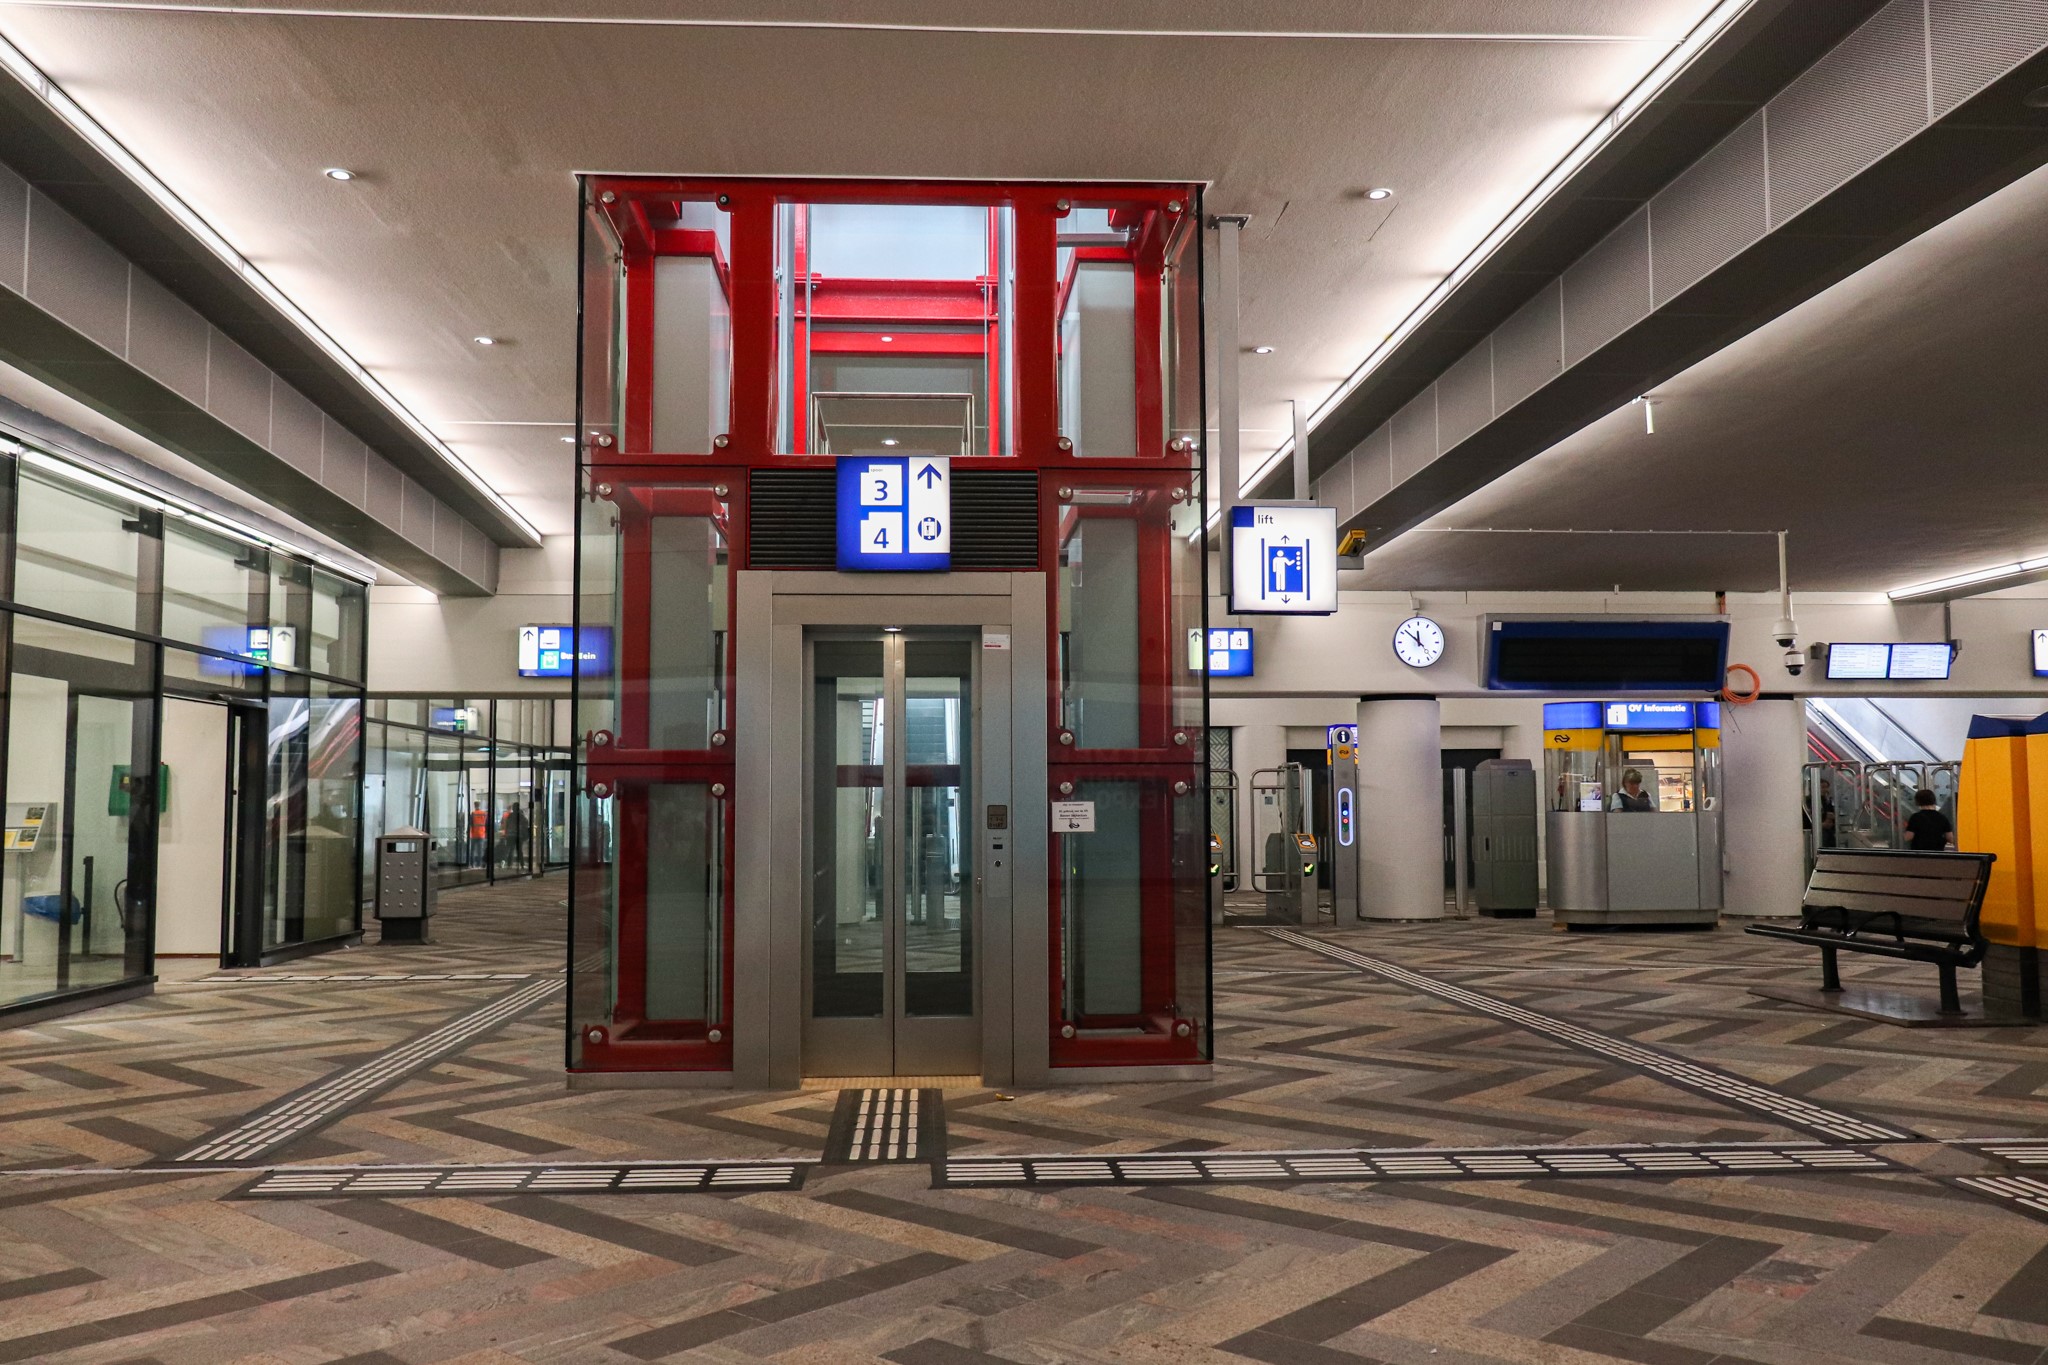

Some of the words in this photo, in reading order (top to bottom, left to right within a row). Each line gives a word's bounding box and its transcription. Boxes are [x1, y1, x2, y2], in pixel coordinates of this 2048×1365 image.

[874, 479, 888, 501] 3
[1257, 514, 1274, 525] lift
[873, 527, 889, 549] 4
[1216, 637, 1222, 648] 3
[1236, 637, 1243, 647] 4
[1628, 703, 1642, 713] OV
[1644, 703, 1687, 713] Informatie
